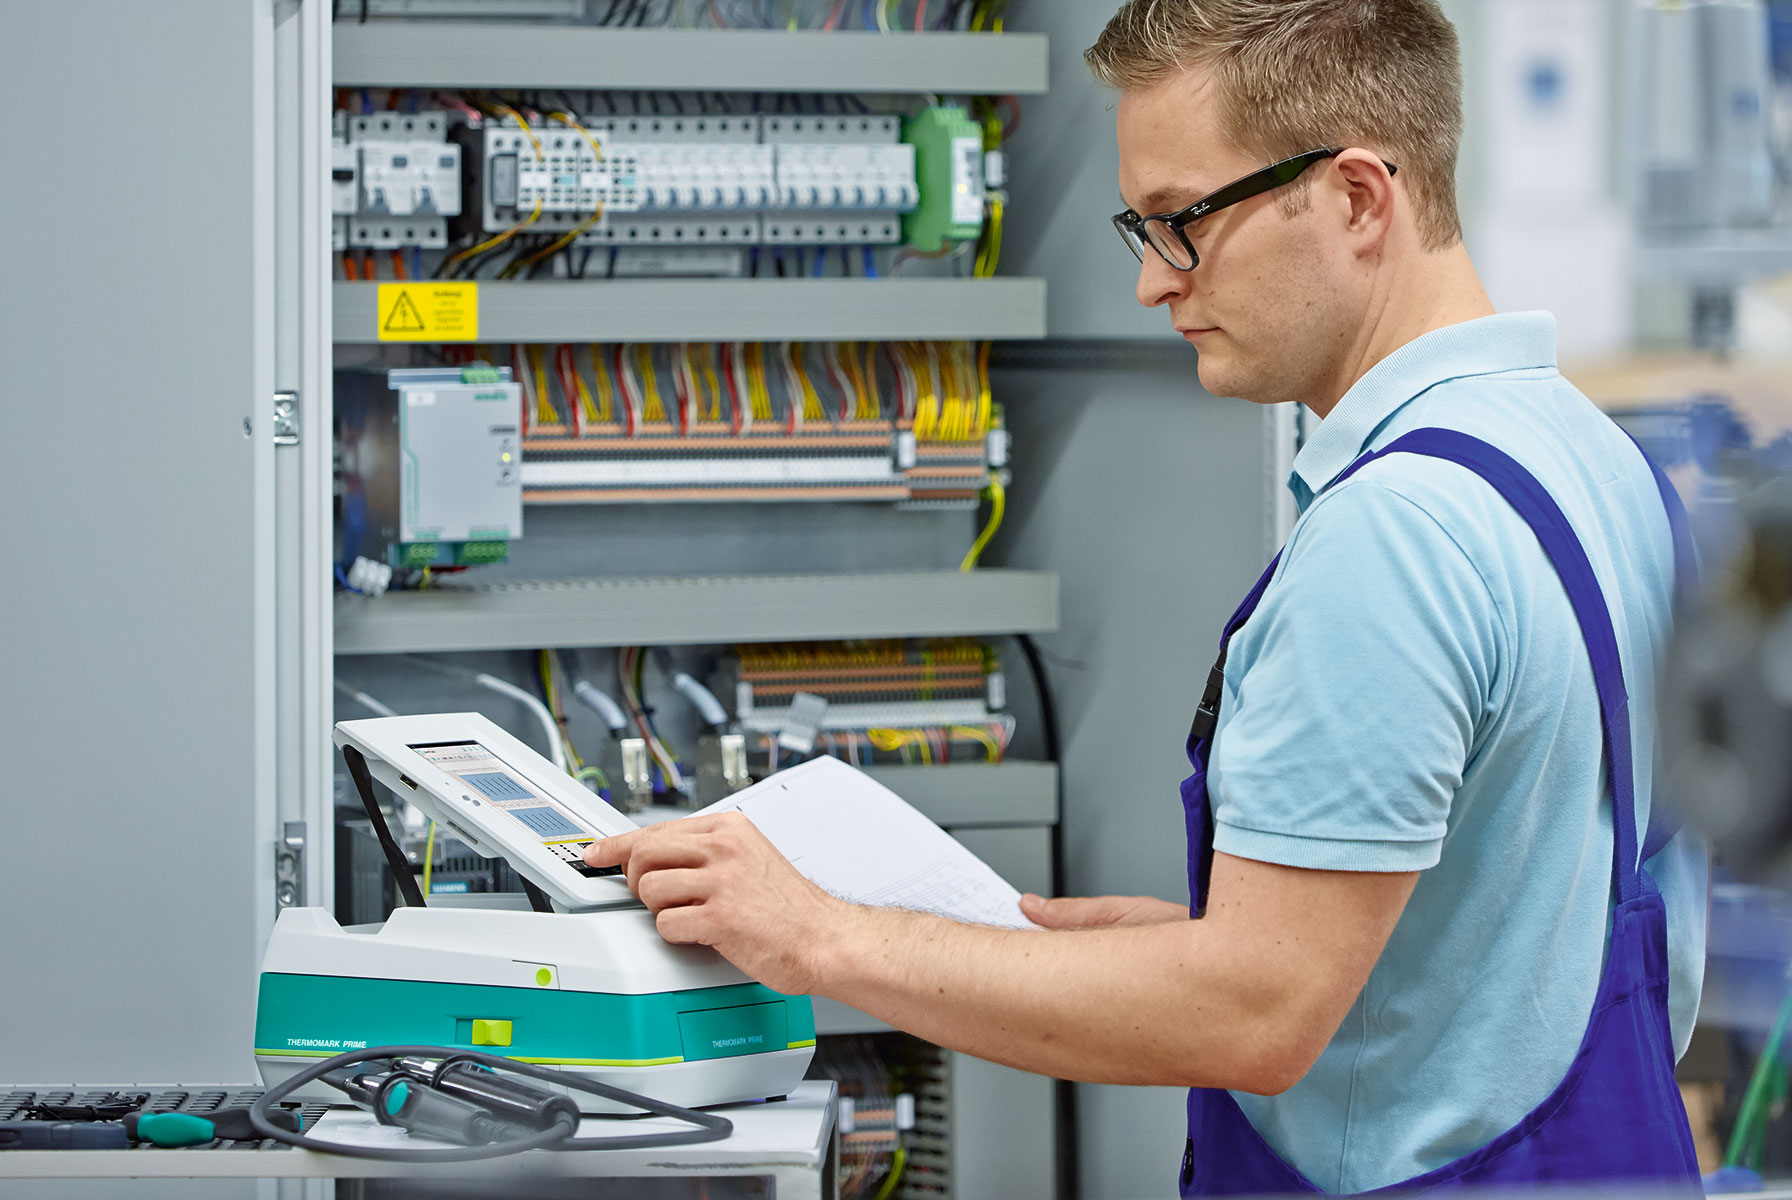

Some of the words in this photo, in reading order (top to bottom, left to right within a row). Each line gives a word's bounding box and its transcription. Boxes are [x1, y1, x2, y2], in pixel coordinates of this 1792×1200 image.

[287, 1039, 340, 1048] THERMOMARK
[342, 1040, 367, 1049] PRIME
[712, 1037, 746, 1048] THERMOMARK
